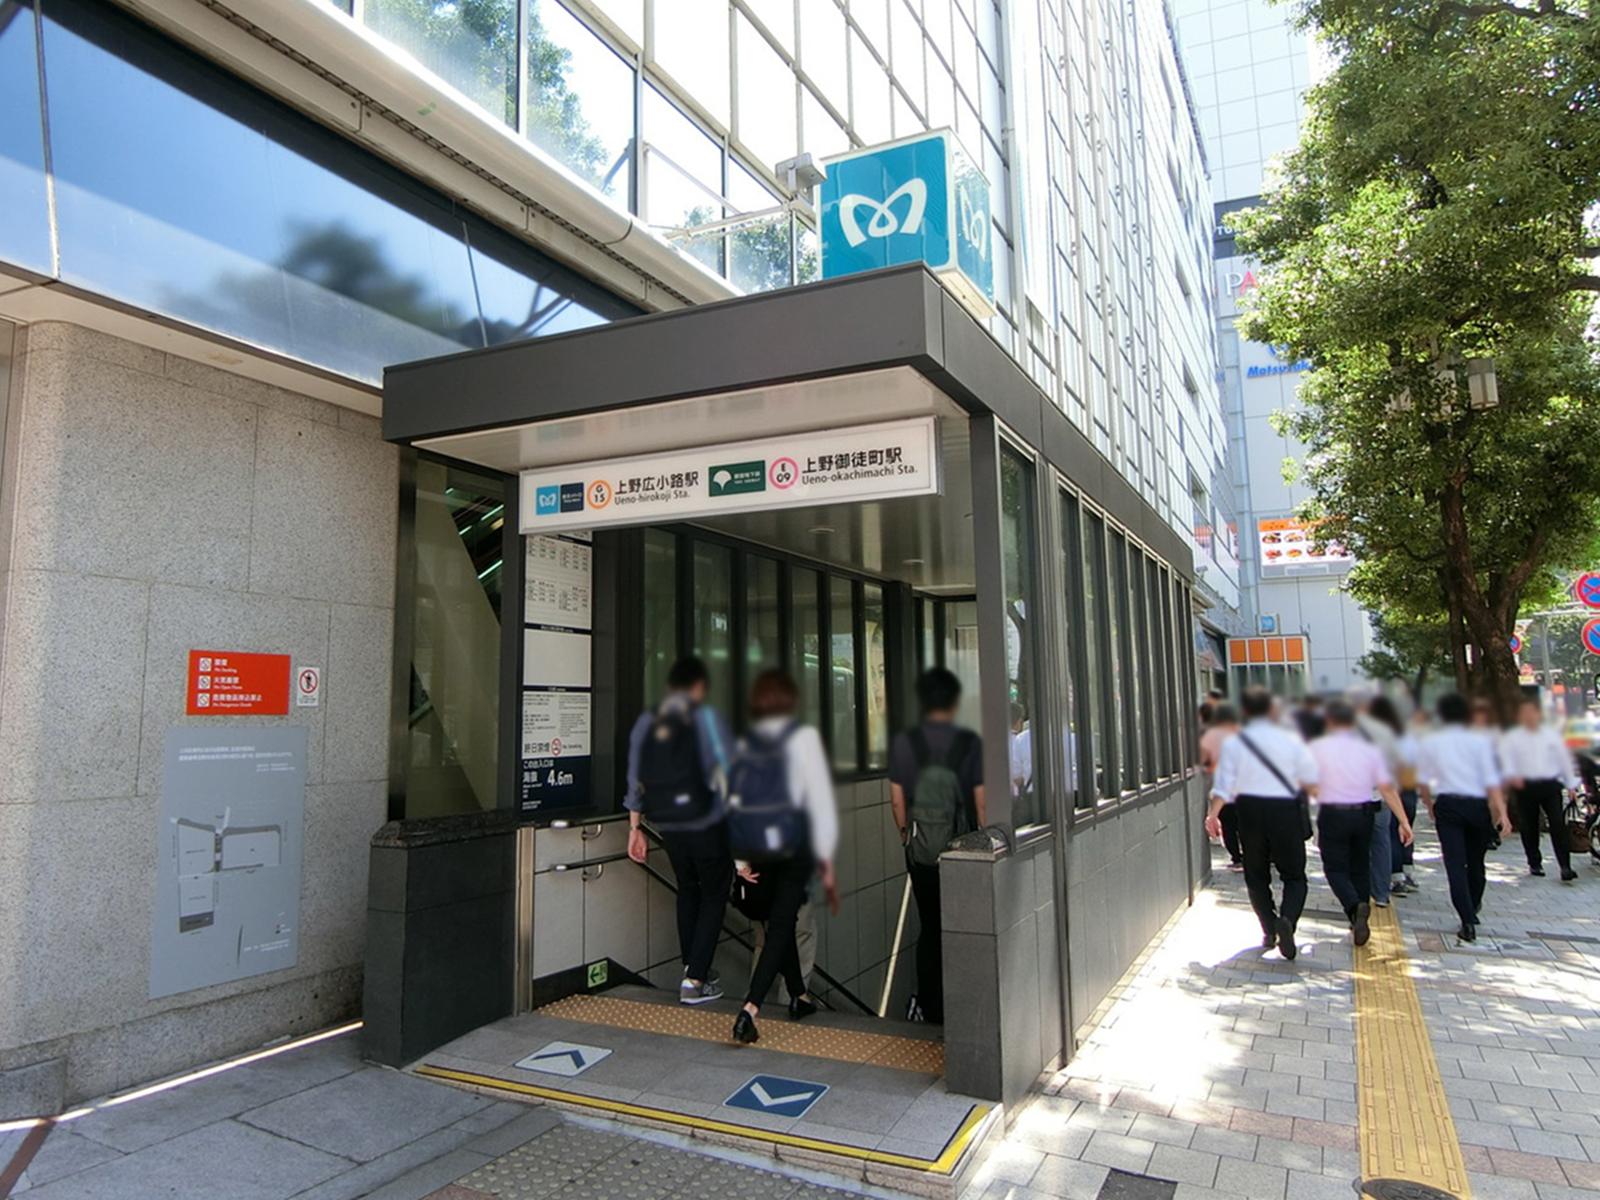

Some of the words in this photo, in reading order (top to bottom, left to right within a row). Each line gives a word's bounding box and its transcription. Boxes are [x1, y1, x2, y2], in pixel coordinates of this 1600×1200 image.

[1225, 270, 1259, 296] PA
[780, 463, 786, 472] E
[802, 447, 902, 474] 上野御徒町駅
[615, 471, 699, 495] 上野広小路駅
[776, 472, 791, 483] 09
[802, 464, 894, 486] Ueno-okachimachi
[897, 463, 918, 475] Sta.
[595, 484, 603, 493] G
[594, 493, 605, 503] 15
[614, 491, 672, 506] Ueno-hirokoji
[673, 489, 690, 500] Sta.
[546, 769, 574, 787] 4.6m
